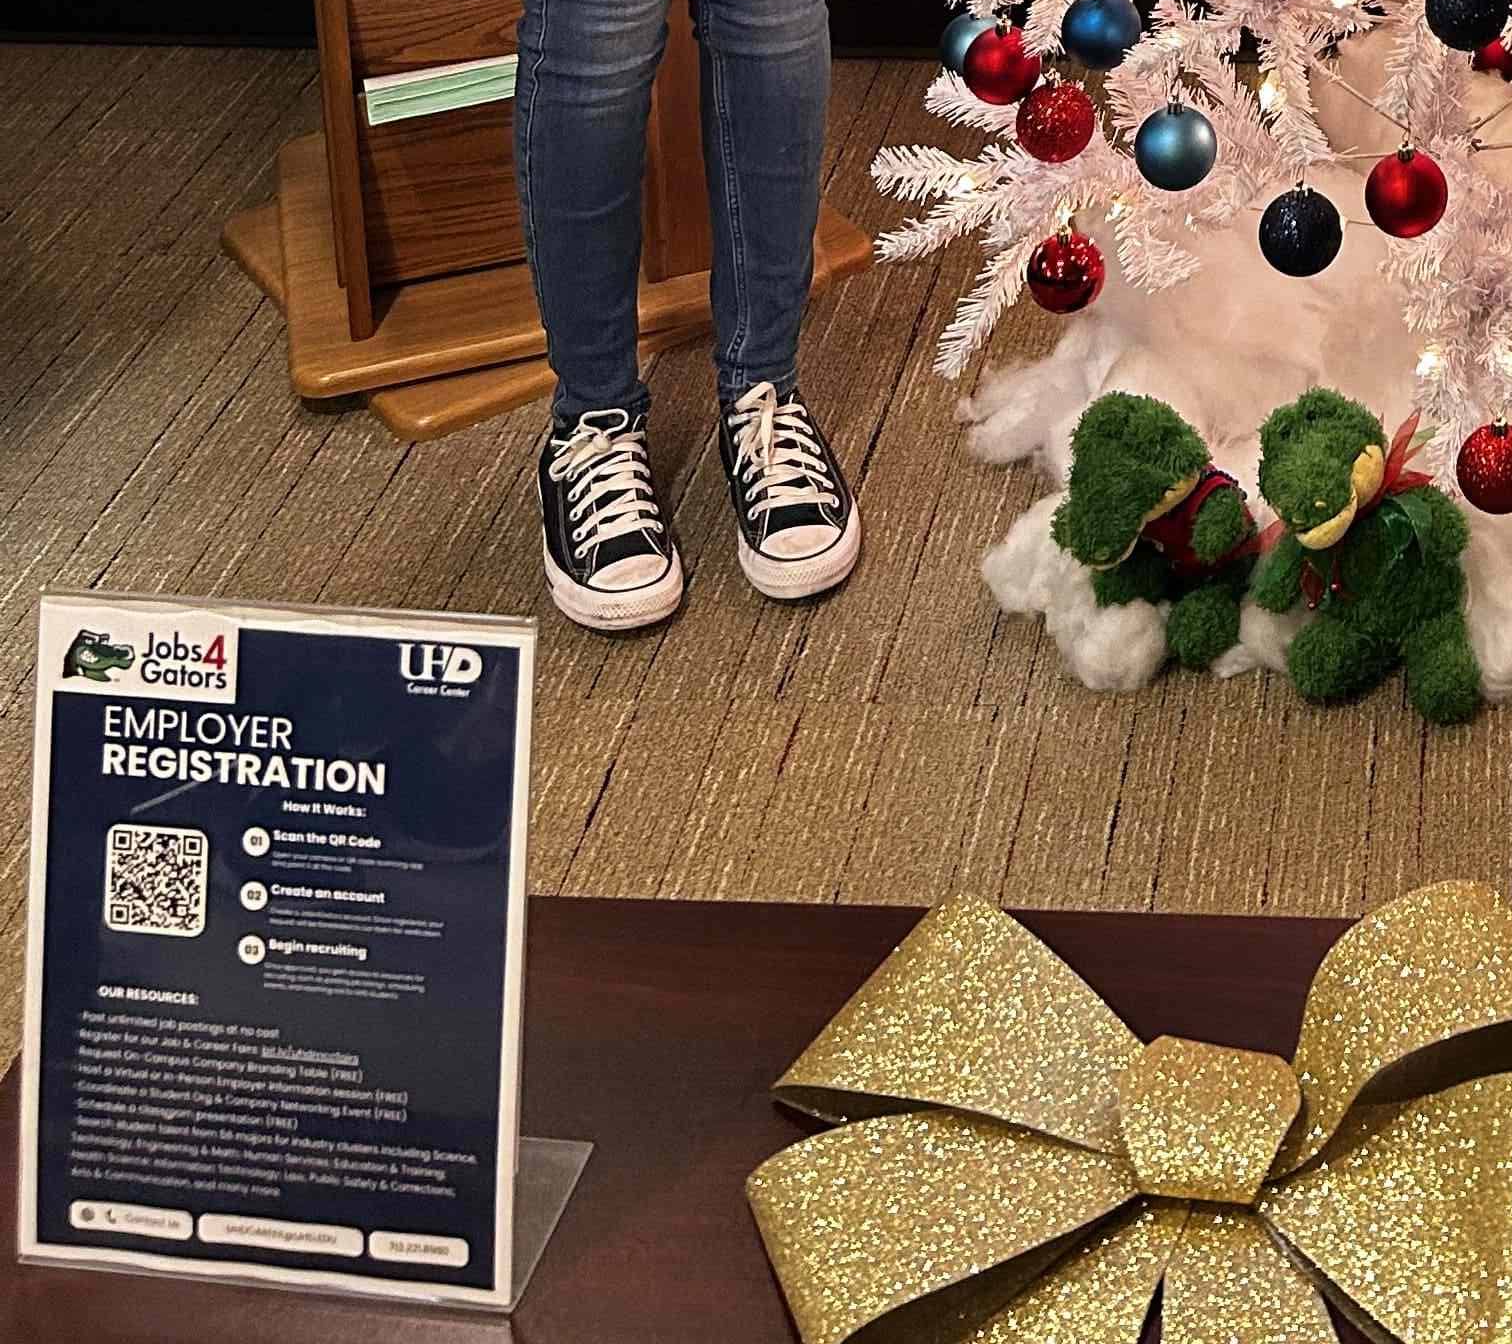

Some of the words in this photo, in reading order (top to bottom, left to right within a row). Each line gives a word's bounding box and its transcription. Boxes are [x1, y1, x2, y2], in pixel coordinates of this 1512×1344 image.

[396, 642, 482, 683] UHD
[140, 658, 227, 690] Gators
[103, 704, 293, 750] EMPLOYER
[101, 742, 387, 796] REGISTRATION
[282, 799, 310, 813] How
[322, 803, 367, 818] Works:
[249, 835, 263, 847] 01
[273, 829, 305, 843] Scan
[306, 833, 327, 845] the
[328, 834, 346, 847] QR
[349, 836, 382, 849] Code
[270, 884, 313, 899] Create
[315, 887, 332, 899] an
[333, 889, 386, 904] account
[268, 938, 304, 954] Begin
[305, 942, 368, 960] recruiting
[97, 984, 124, 999] OUR
[126, 987, 200, 1005] RESOURCES:
